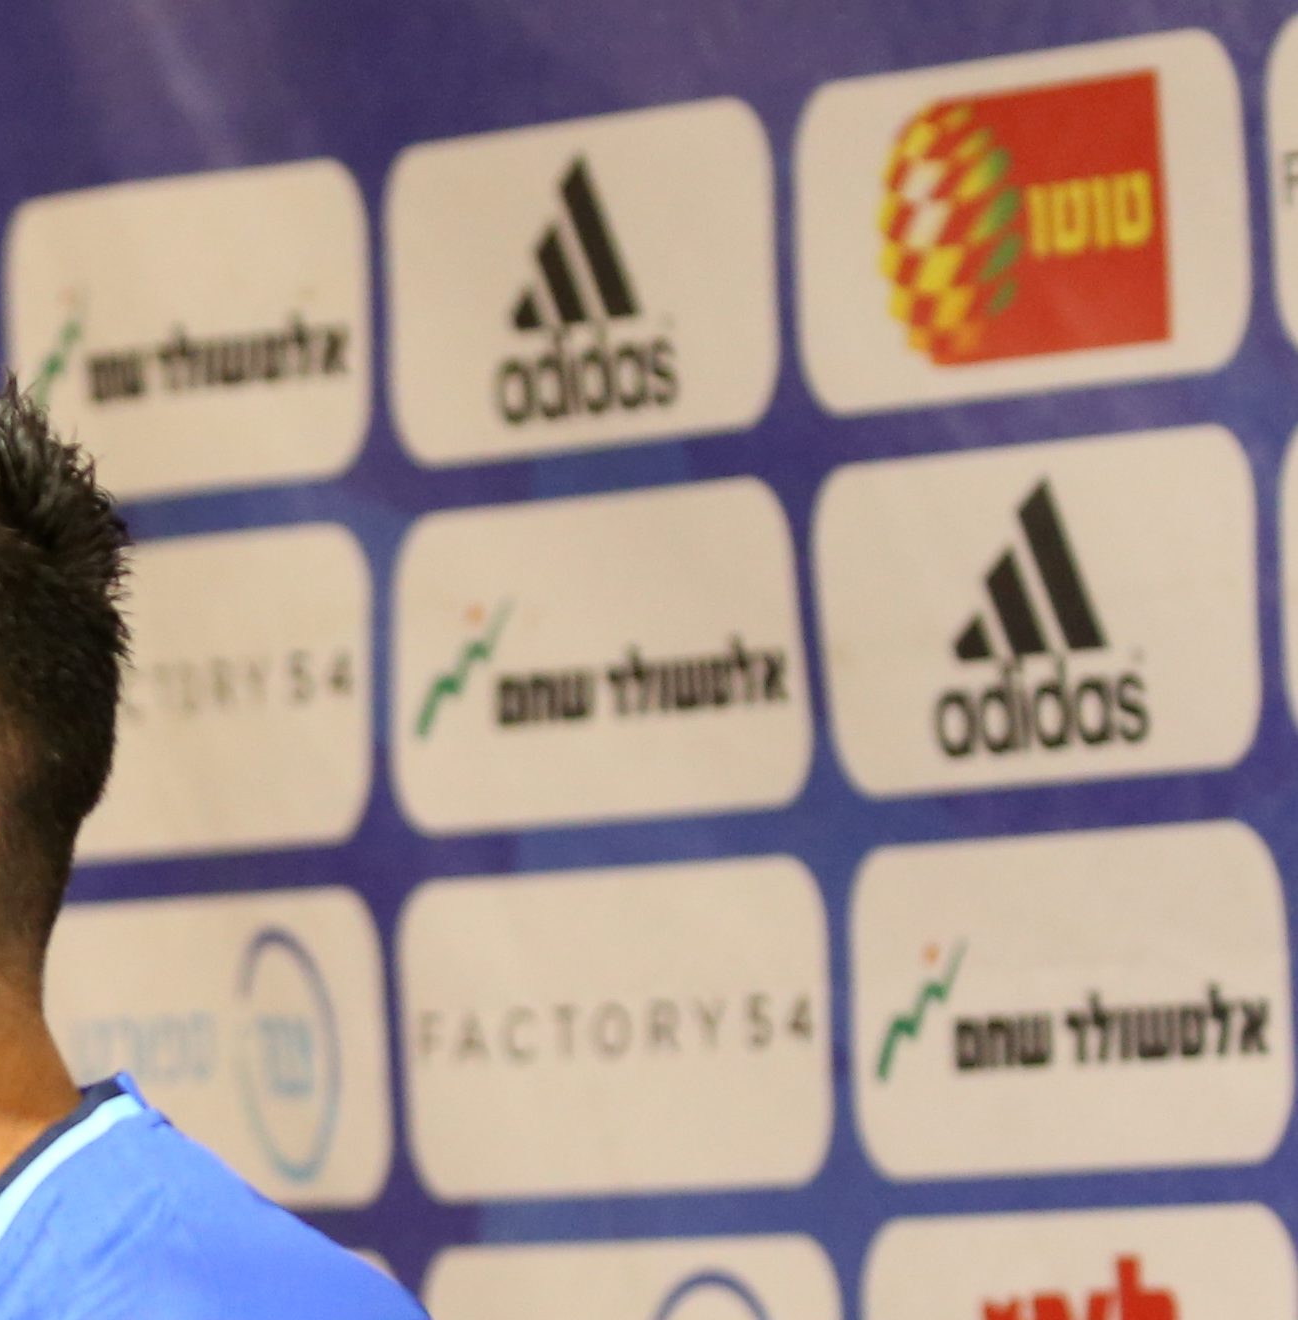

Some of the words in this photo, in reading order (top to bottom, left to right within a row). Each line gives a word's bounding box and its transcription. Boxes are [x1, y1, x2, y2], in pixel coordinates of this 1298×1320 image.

[1024, 169, 1153, 261] טוטו
[495, 326, 680, 425] adidas
[933, 657, 1150, 760] adidas
